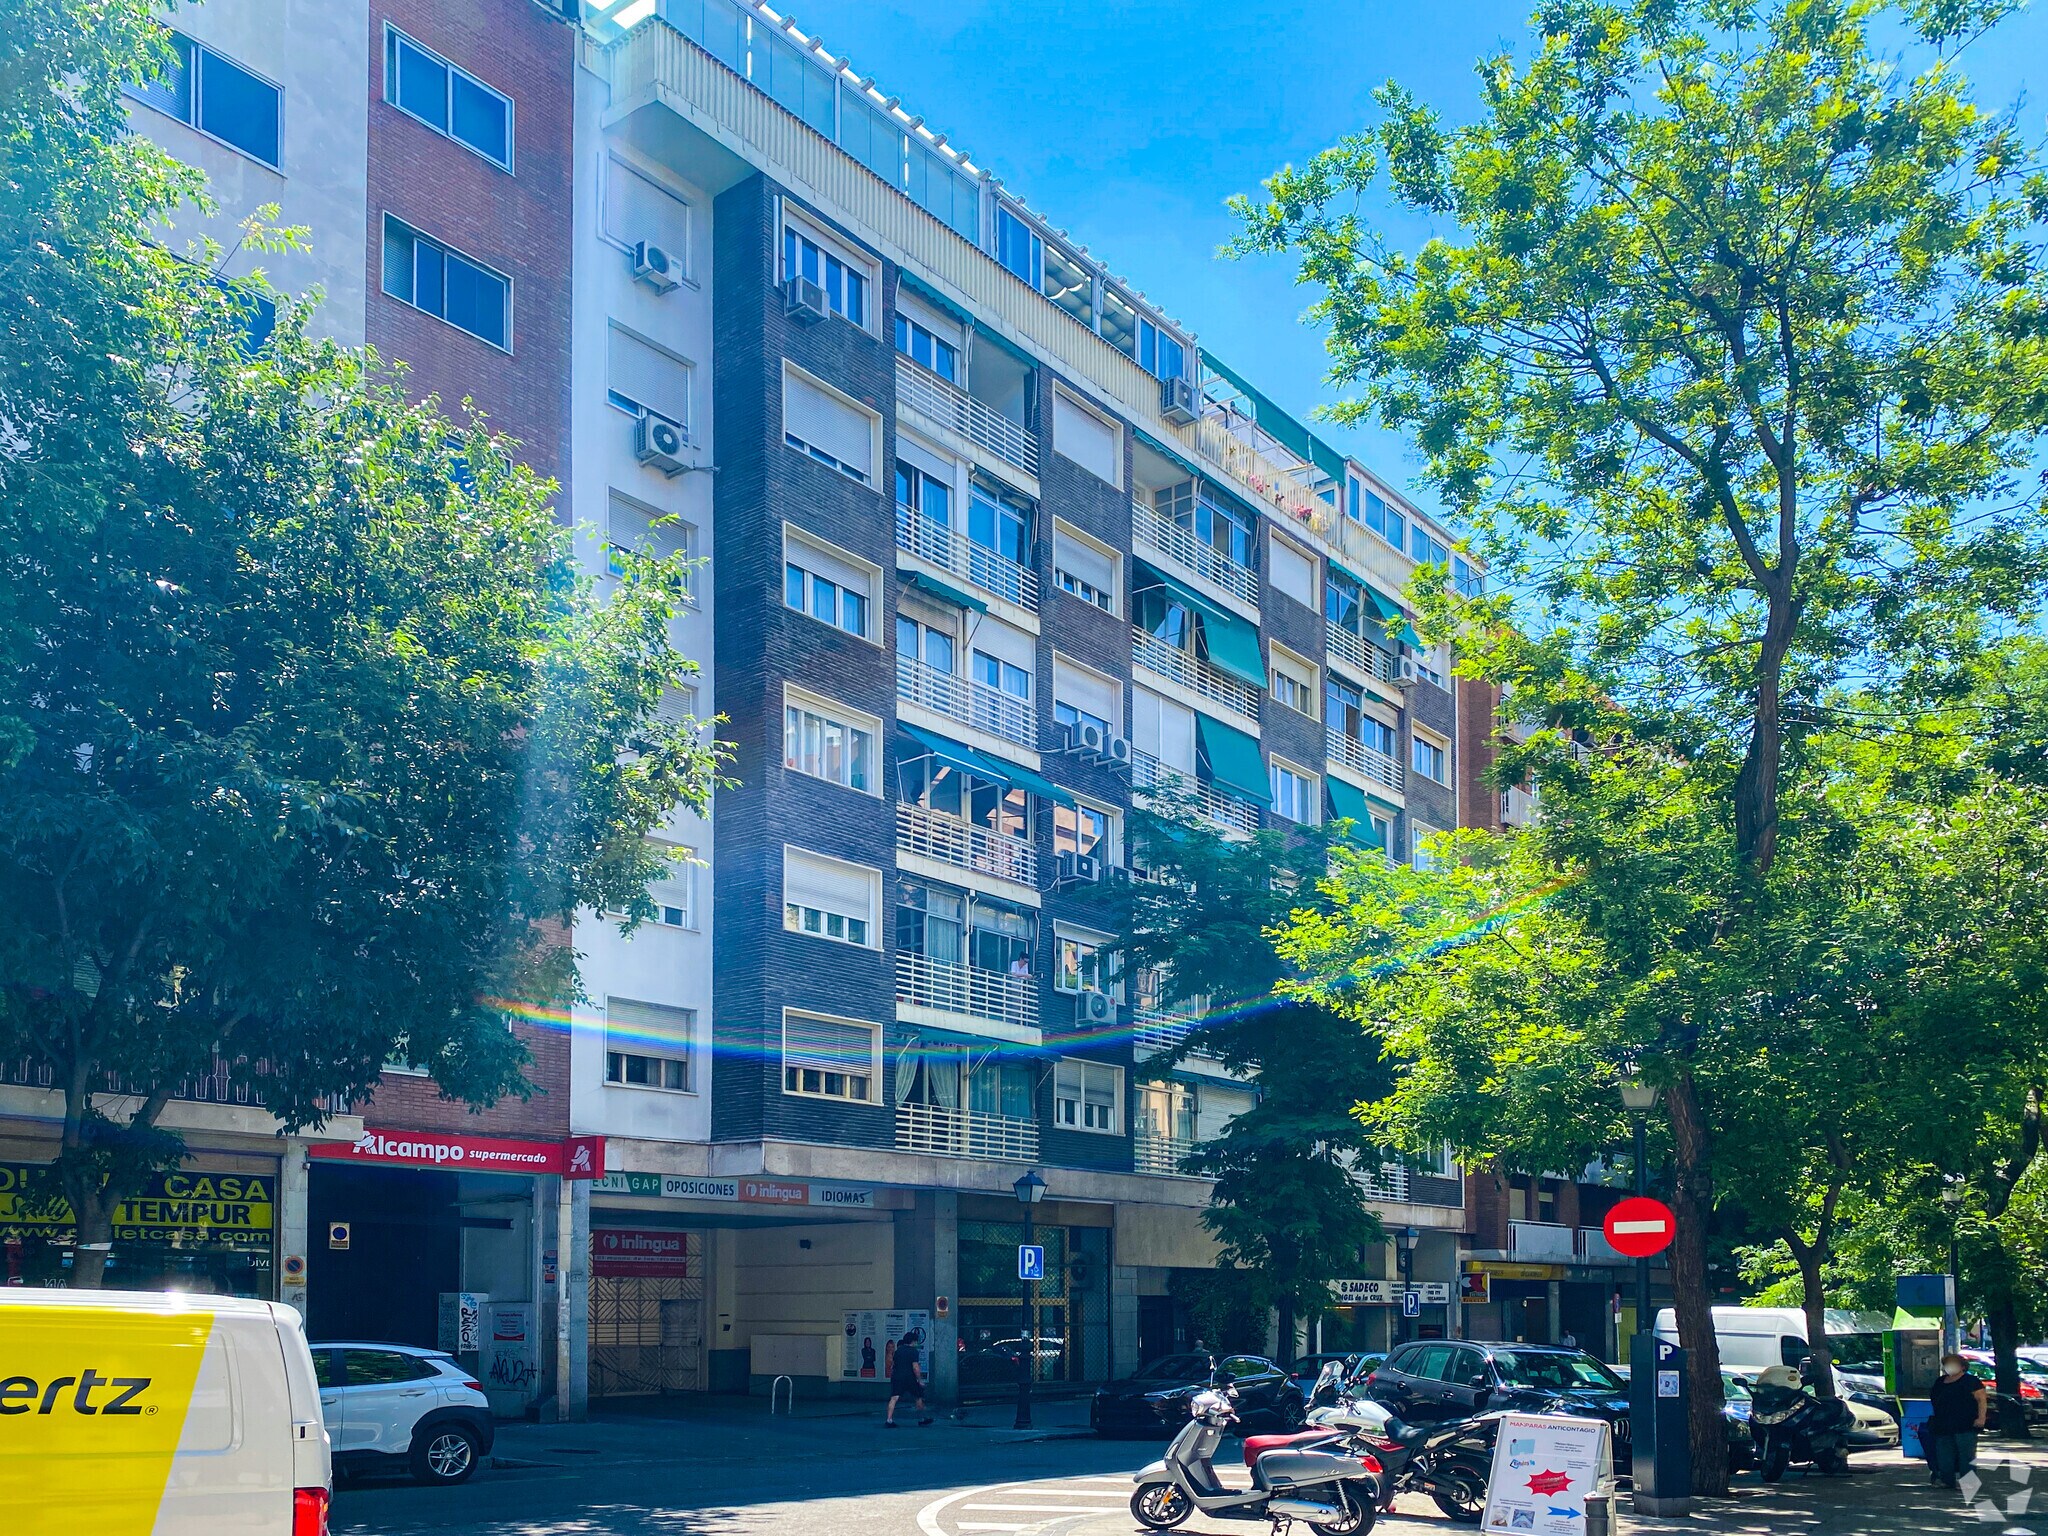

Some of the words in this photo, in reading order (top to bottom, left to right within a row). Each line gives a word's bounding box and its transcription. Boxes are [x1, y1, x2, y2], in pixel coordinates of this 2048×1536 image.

[353, 1130, 464, 1163] Alcampo
[469, 1148, 547, 1164] supermercado
[164, 1176, 268, 1201] CASA
[666, 1180, 735, 1196] OPOSICIONES
[759, 1183, 802, 1202] inlingua
[821, 1190, 866, 1204] IDIOMAS
[119, 1200, 250, 1225] TEMPUR
[621, 1234, 680, 1253] inlingua
[1024, 1248, 1036, 1275] P
[1349, 1282, 1379, 1293] SADECO
[1659, 1344, 1673, 1360] P
[0, 1369, 152, 1416] ertz
[1547, 1424, 1596, 1434] ANTICONTAGIO
